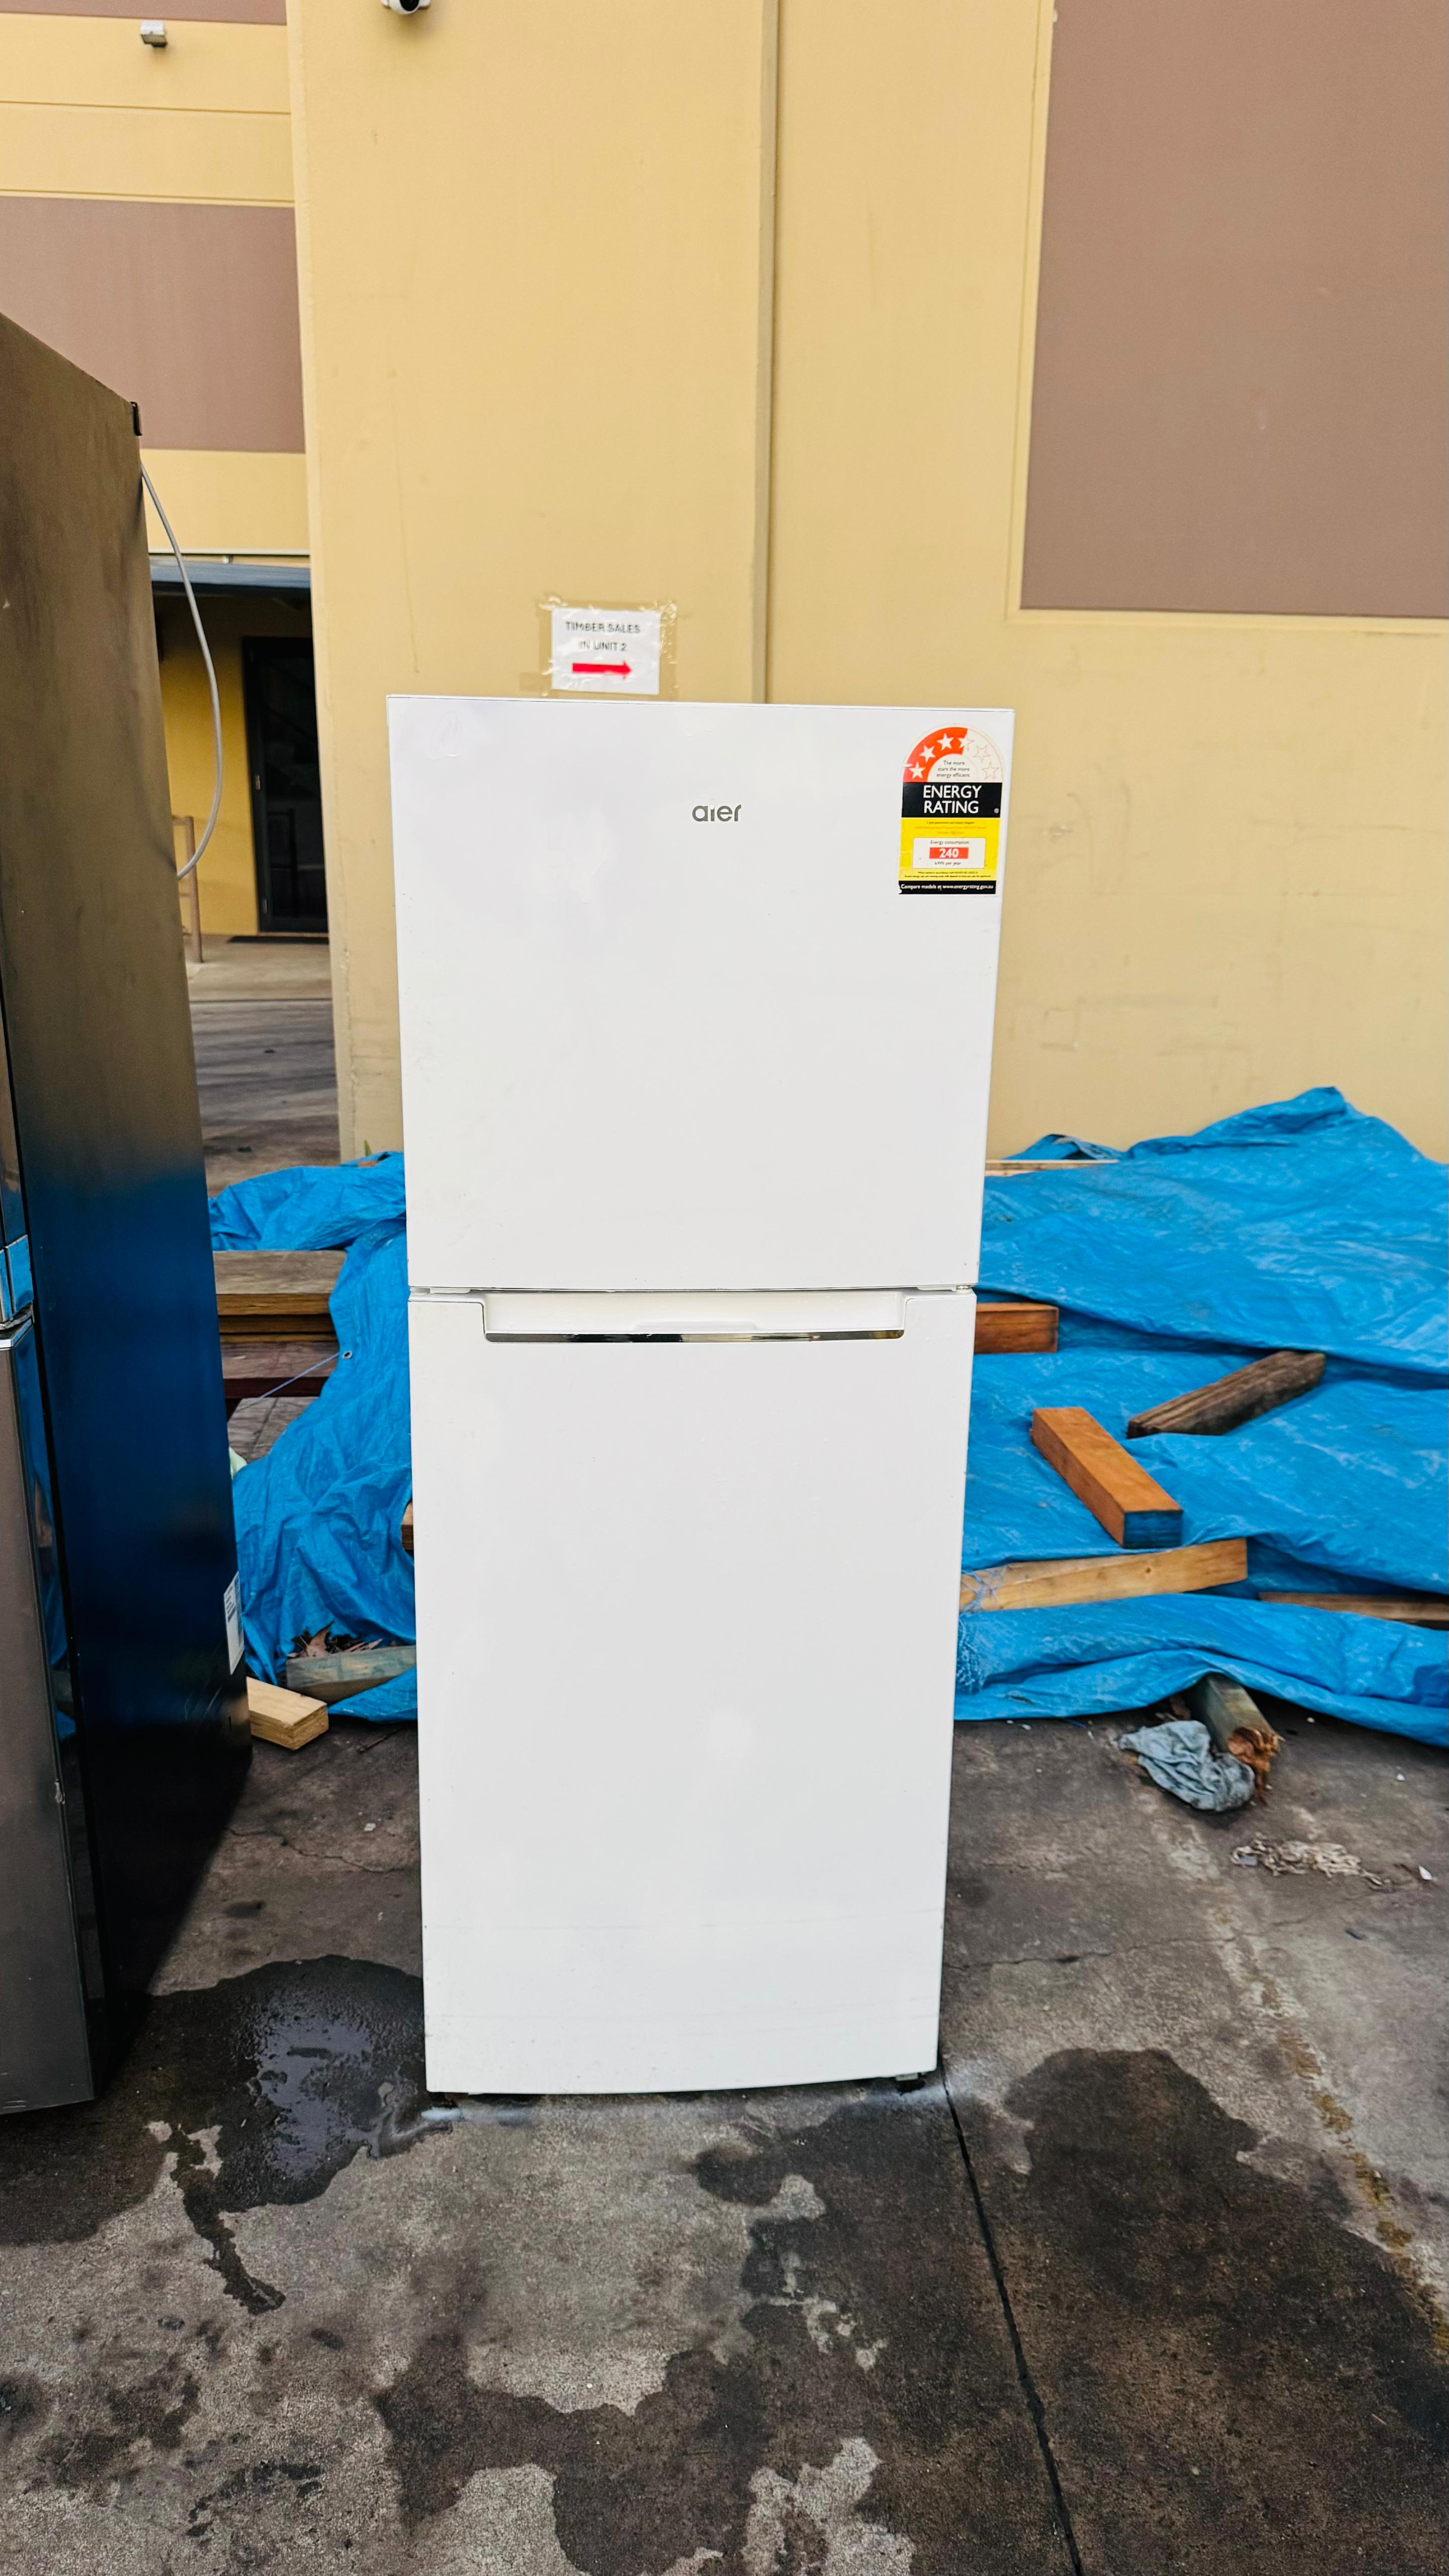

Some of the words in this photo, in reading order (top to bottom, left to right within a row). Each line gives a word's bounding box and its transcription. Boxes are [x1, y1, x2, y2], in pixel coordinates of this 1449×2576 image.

[566, 621, 605, 632] TIMBER
[608, 624, 640, 633] SALES
[579, 640, 590, 650] IN
[594, 641, 618, 651] UNIT
[621, 642, 627, 652] 2
[923, 785, 982, 798] ENERGY
[924, 800, 979, 814] RATING
[939, 848, 959, 858] 240
